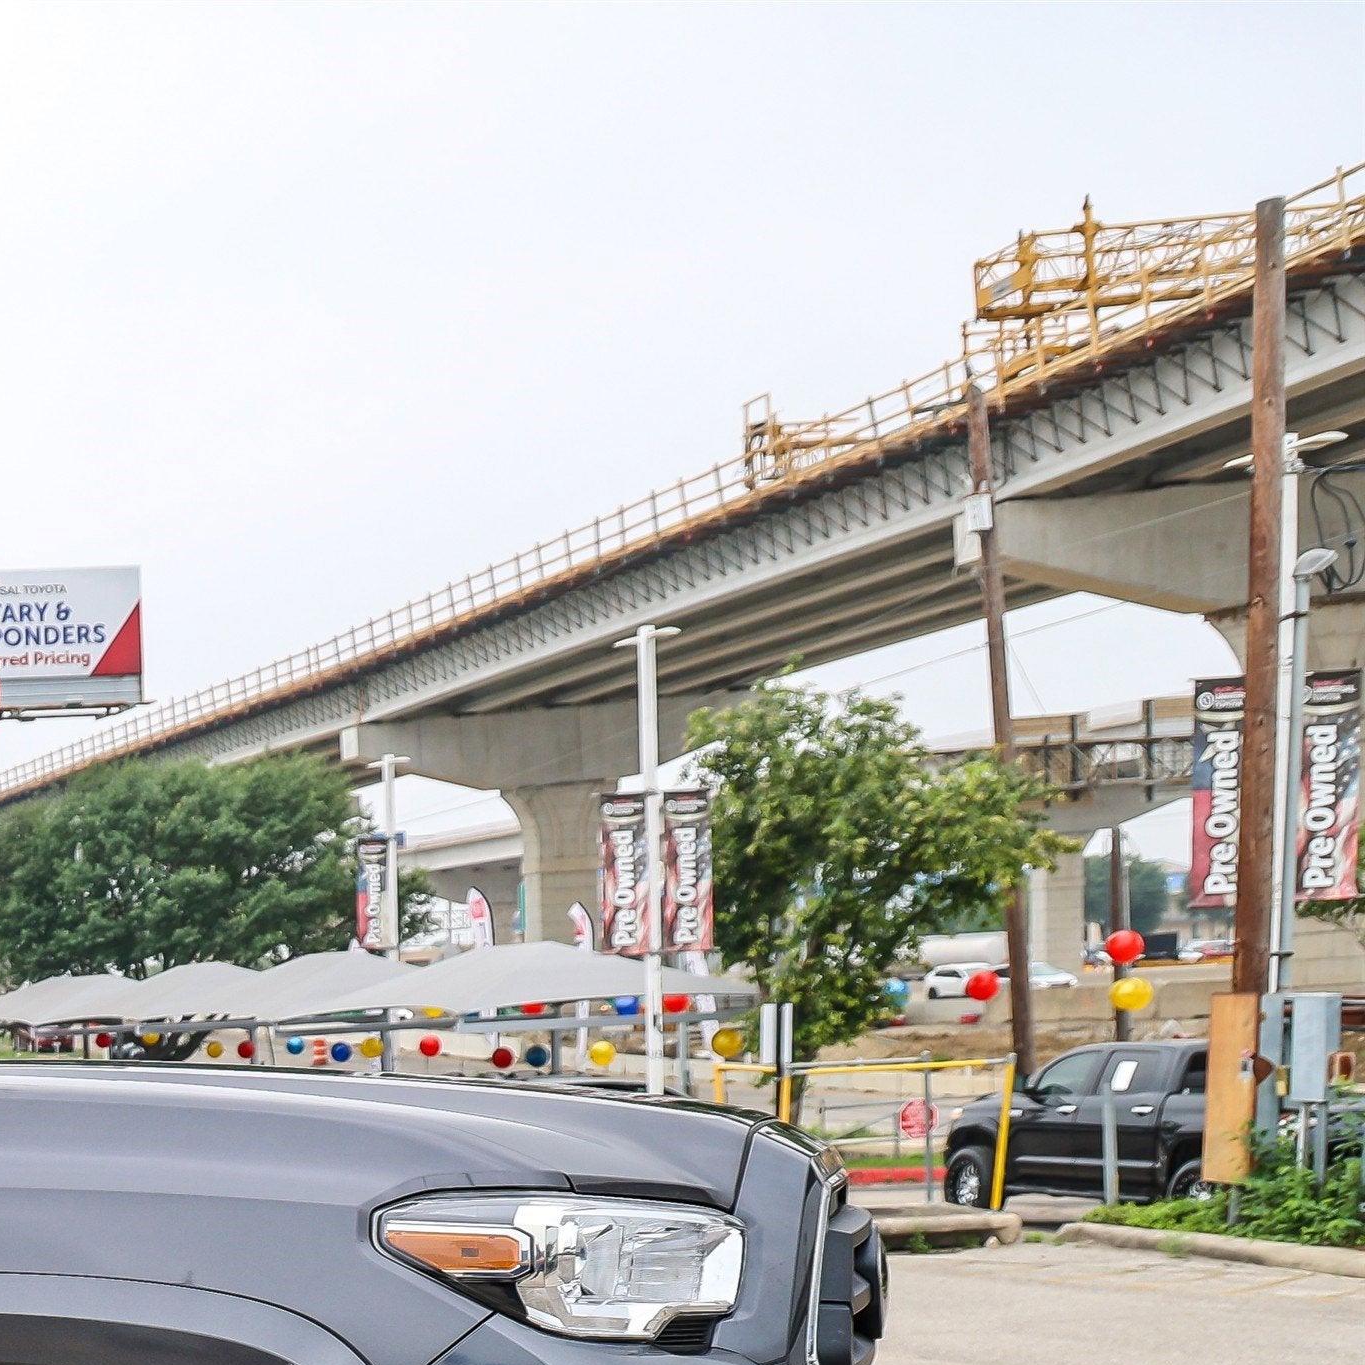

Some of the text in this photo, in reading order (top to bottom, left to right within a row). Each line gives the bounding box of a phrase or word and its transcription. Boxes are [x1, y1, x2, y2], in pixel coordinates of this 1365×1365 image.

[23, 583, 67, 595] TOYOTA
[56, 601, 71, 621] &
[34, 651, 91, 667] Pricing
[1205, 730, 1239, 838] Owned
[1304, 724, 1338, 832] Owned
[609, 829, 635, 907] Owned
[671, 827, 698, 903] Owned
[1203, 841, 1238, 895] Pre
[1302, 835, 1336, 888] Pre
[611, 909, 637, 947] Pre
[673, 906, 698, 944] Pre
